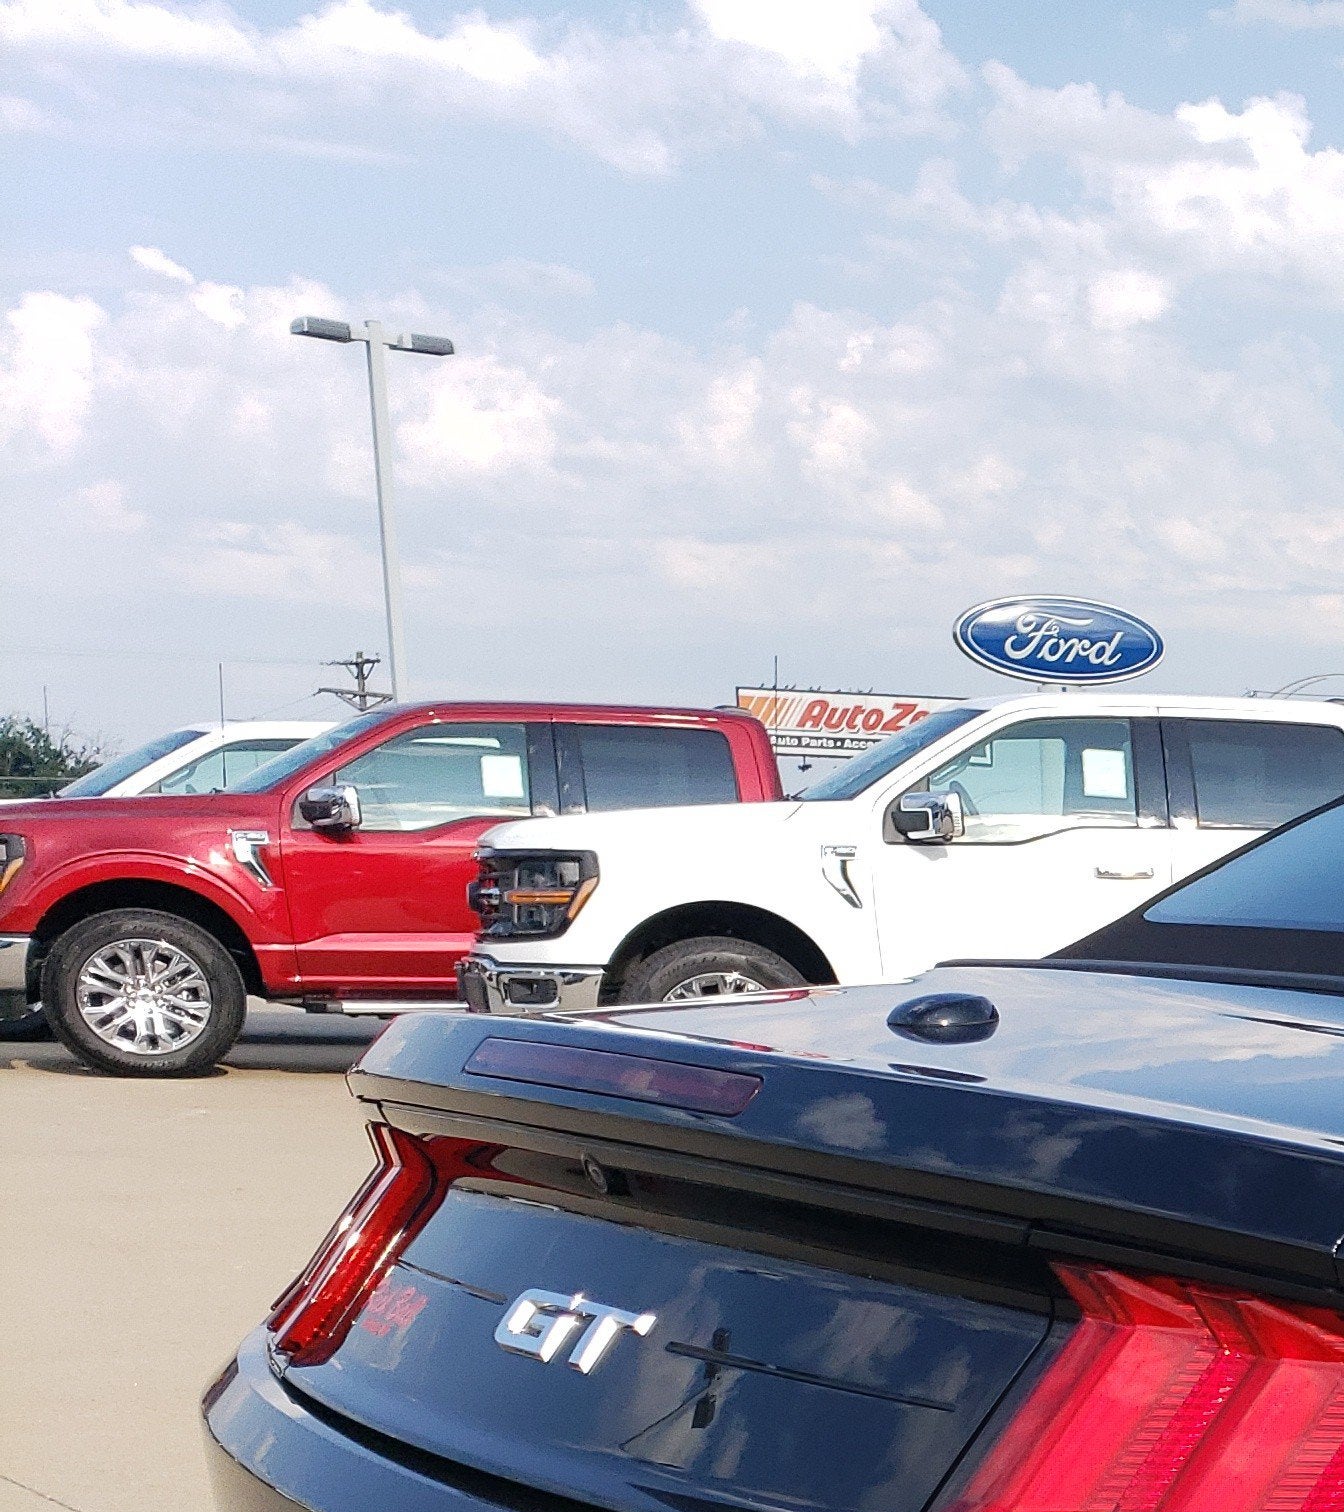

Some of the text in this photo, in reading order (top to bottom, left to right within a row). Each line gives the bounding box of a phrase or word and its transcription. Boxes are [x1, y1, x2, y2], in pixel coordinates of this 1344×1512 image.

[1004, 611, 1124, 666] Ford
[801, 737, 835, 749] Parts
[494, 1288, 657, 1375] GT
